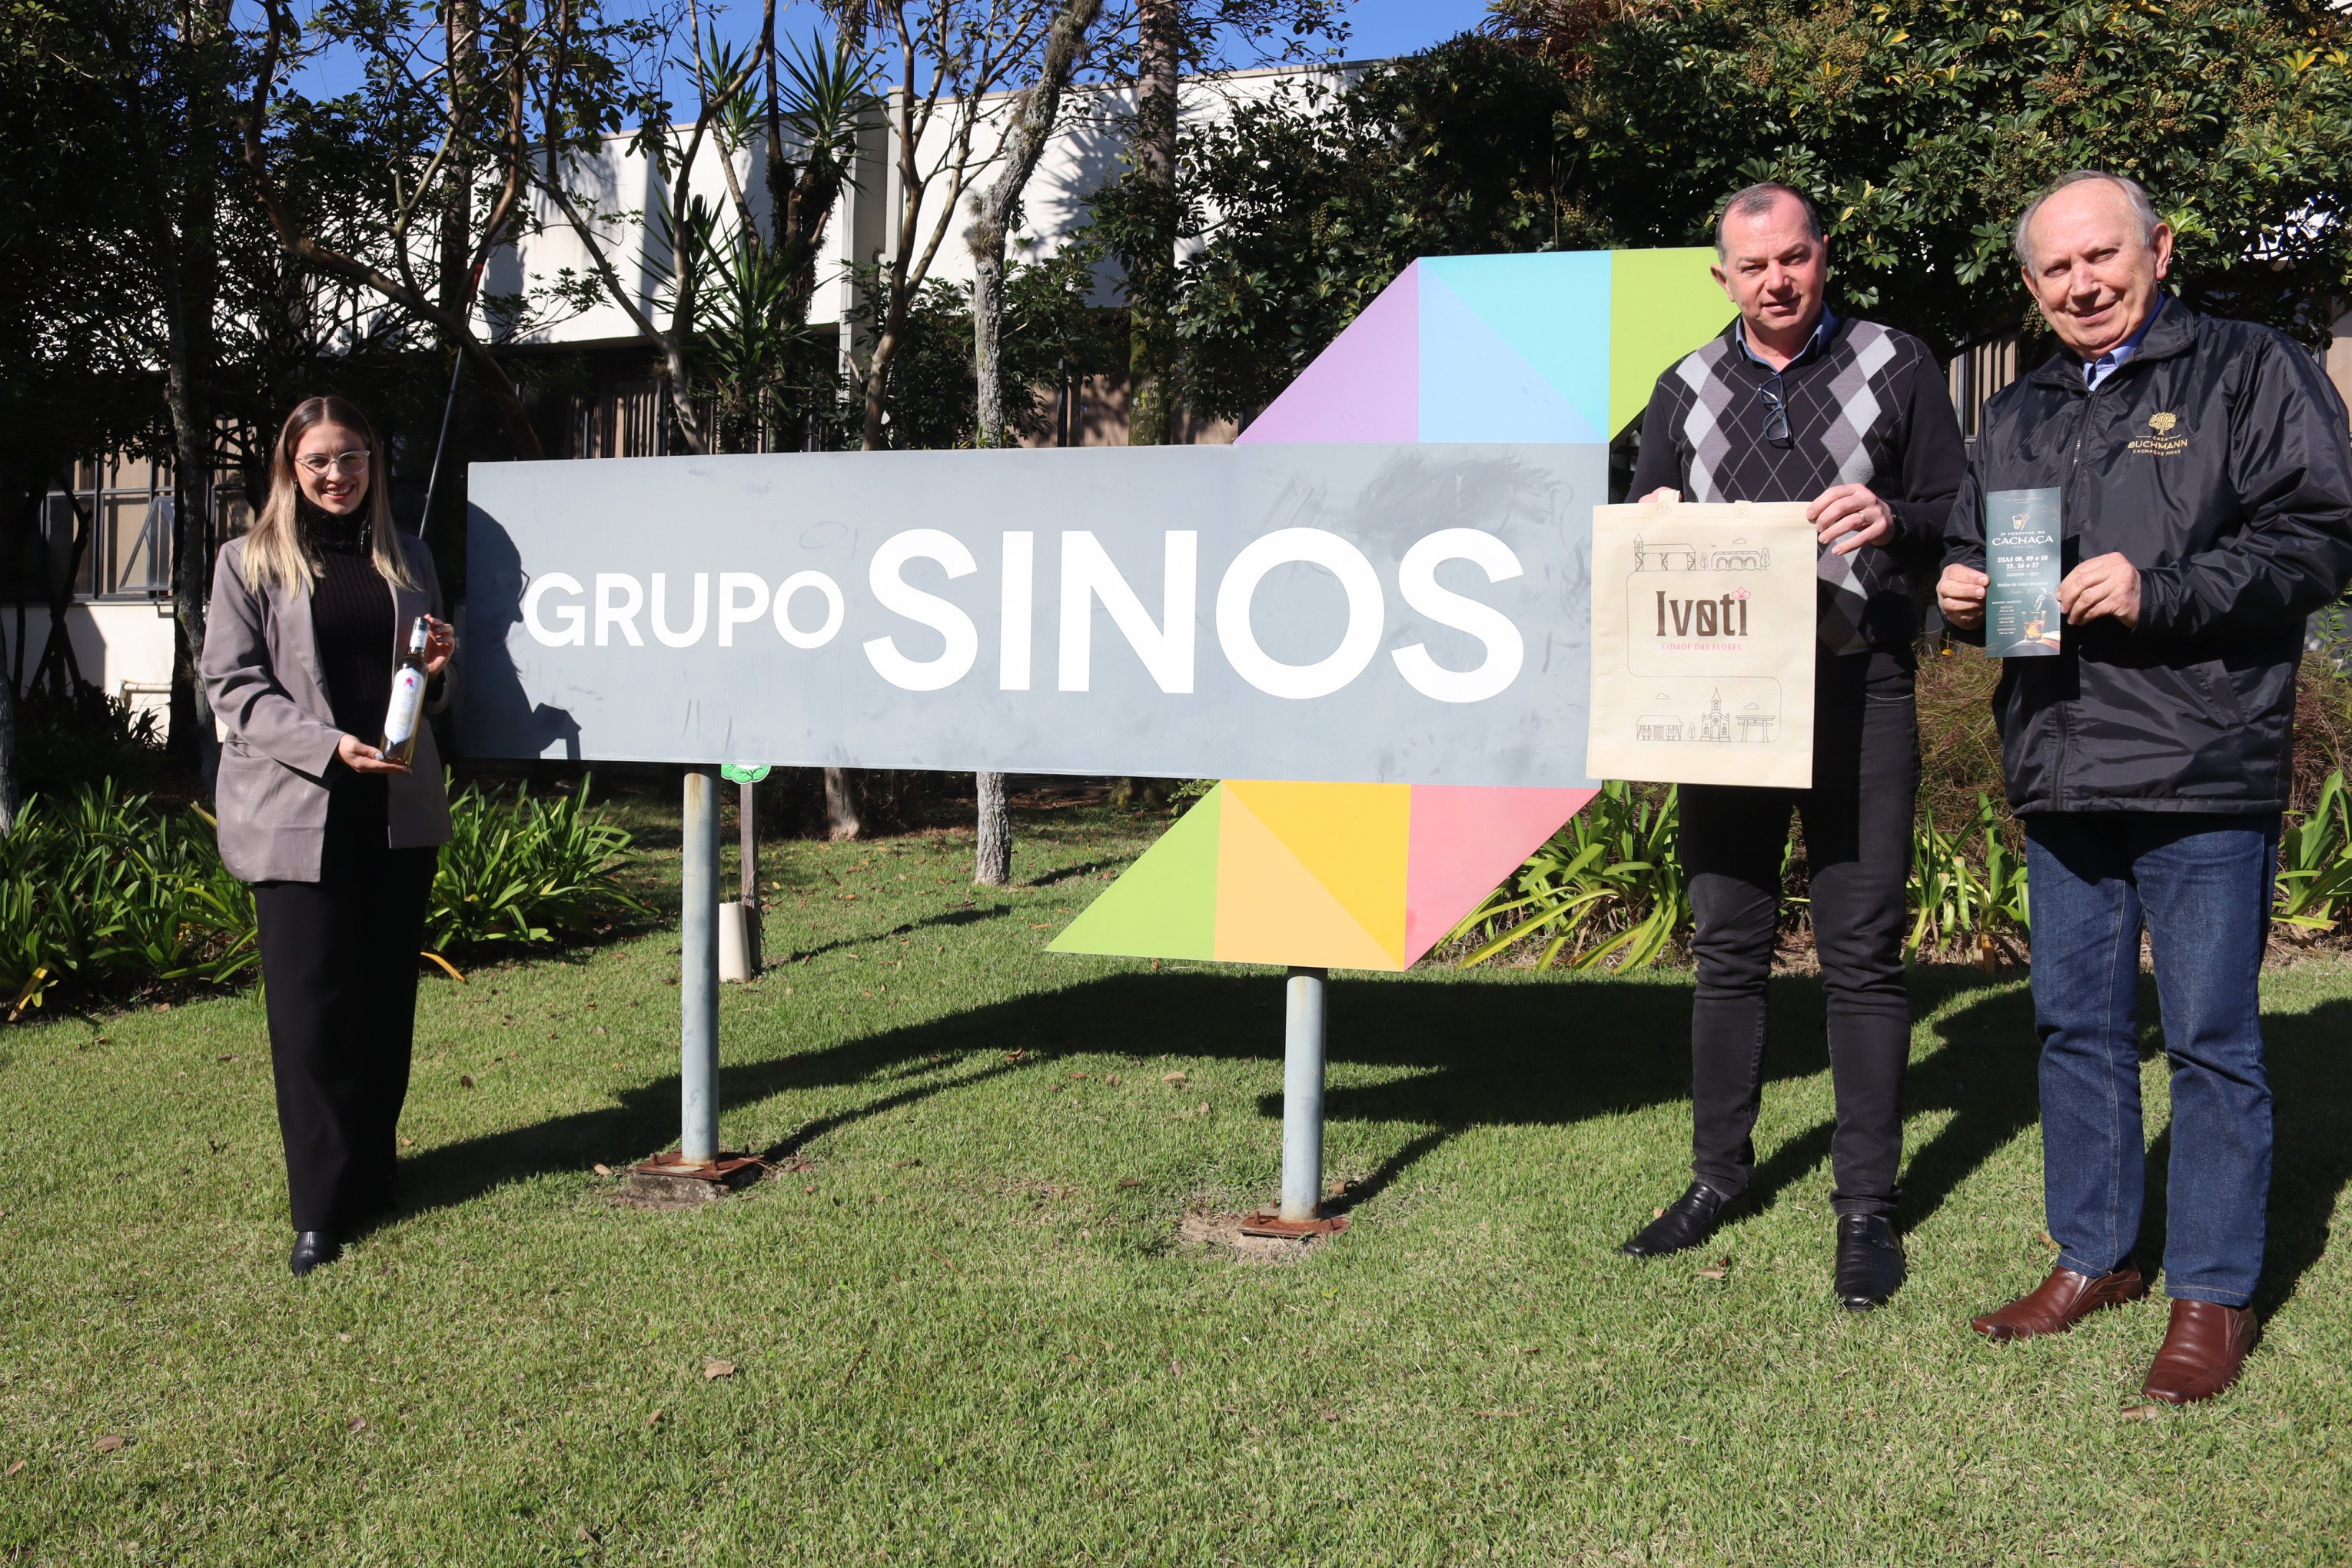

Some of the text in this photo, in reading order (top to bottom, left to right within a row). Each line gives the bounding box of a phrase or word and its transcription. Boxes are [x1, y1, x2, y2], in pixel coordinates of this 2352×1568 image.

[2128, 439, 2188, 450] BUCHMANN
[1992, 535, 2054, 546] CACHAÇA
[523, 526, 1525, 703] GRUPO SINOS
[1662, 643, 1742, 651] CIDADE DAS FLORES
